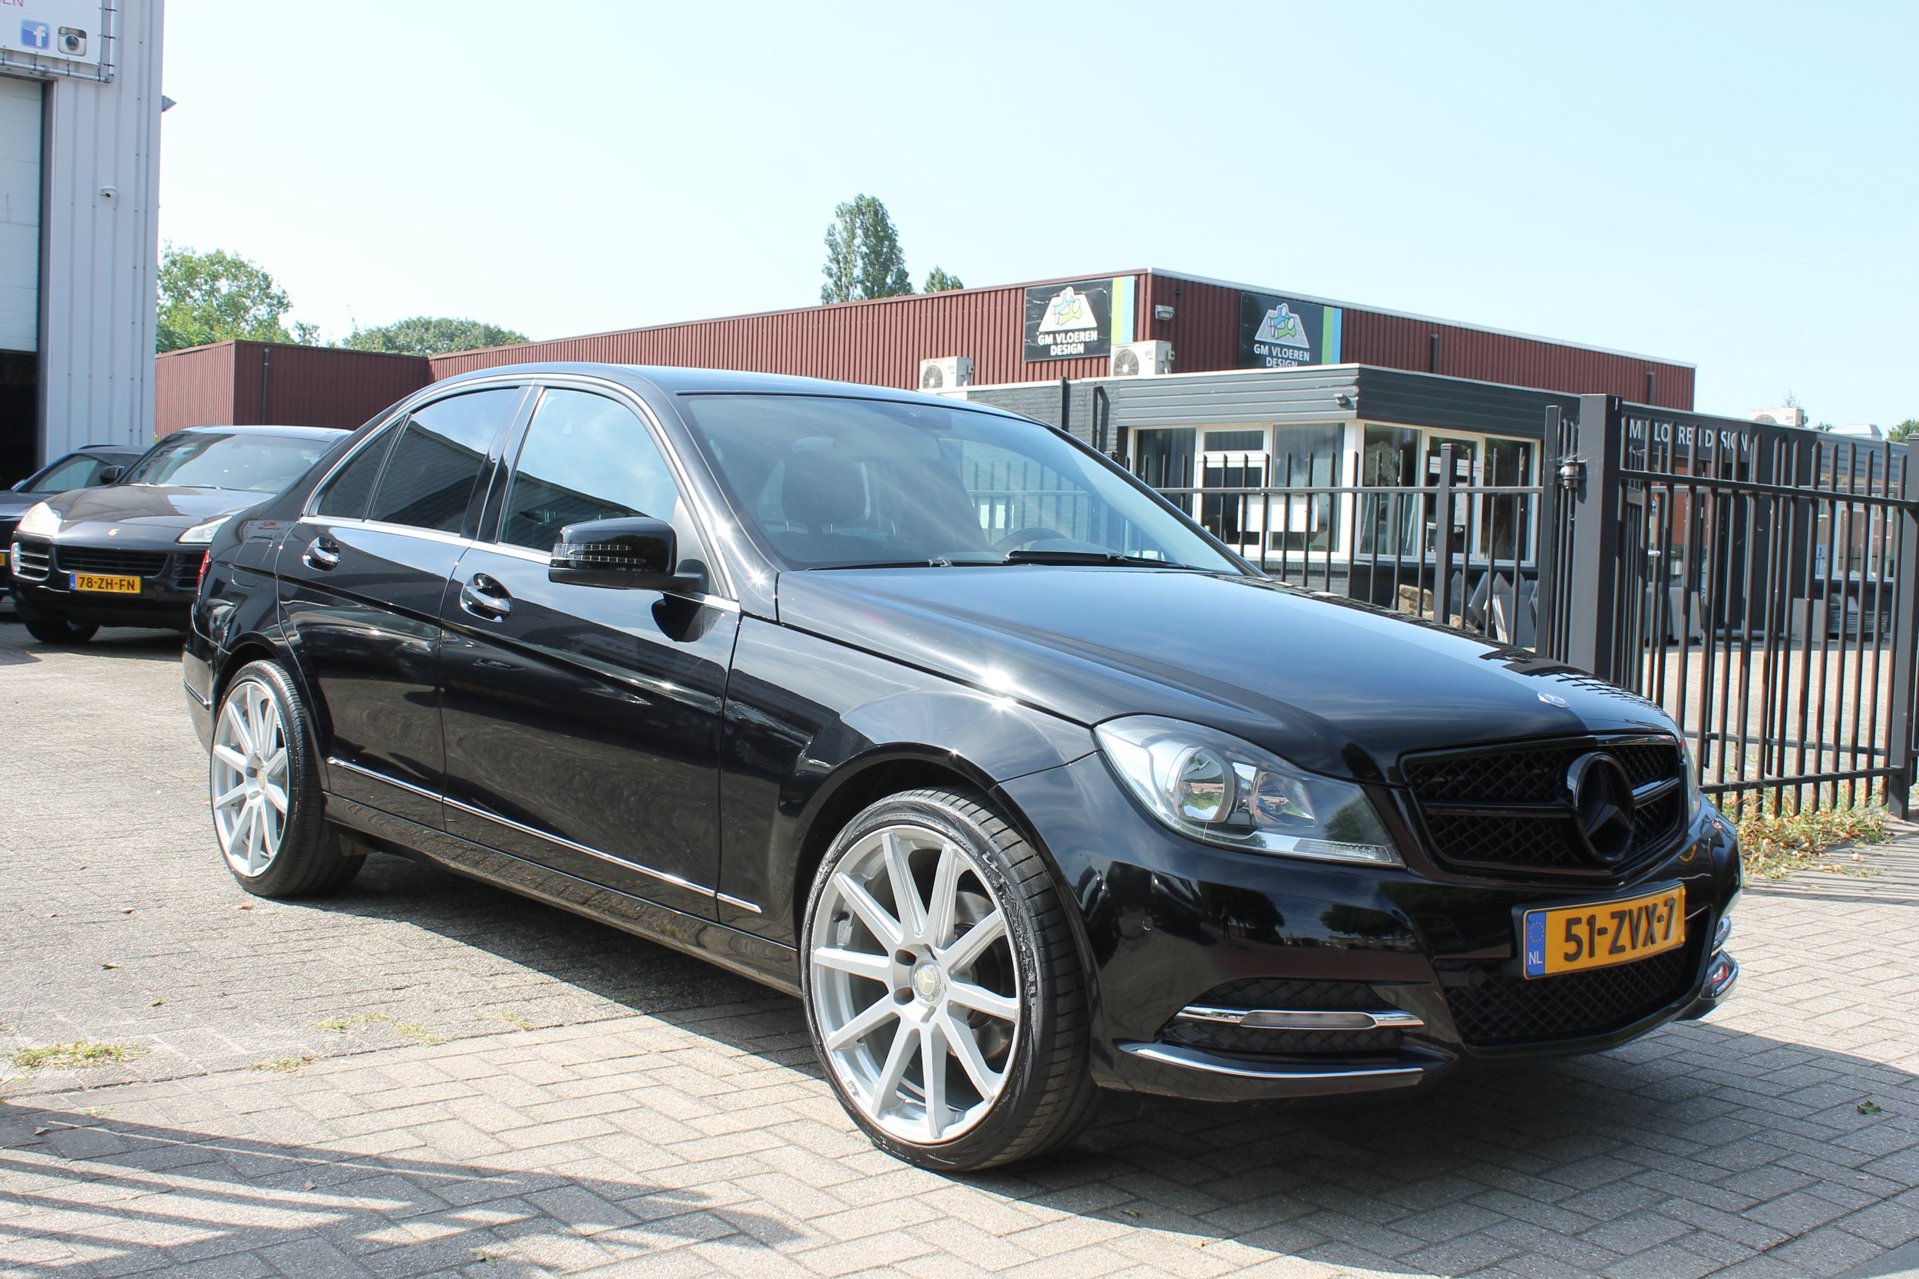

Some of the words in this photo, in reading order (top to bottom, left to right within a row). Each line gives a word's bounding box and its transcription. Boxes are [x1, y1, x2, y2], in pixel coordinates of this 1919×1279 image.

[1037, 333, 1053, 346] GM
[1055, 330, 1098, 344] VLOEREN
[1050, 343, 1085, 356] DESIGN
[1253, 343, 1269, 356] GM
[1271, 345, 1310, 361] VLOEREN
[1266, 356, 1298, 368] DESIGN
[1645, 420, 1702, 447] LORE
[78, 576, 135, 591] 78-ZH-FN
[1563, 896, 1677, 963] 51-ZVX-7
[1528, 950, 1543, 965] NL
